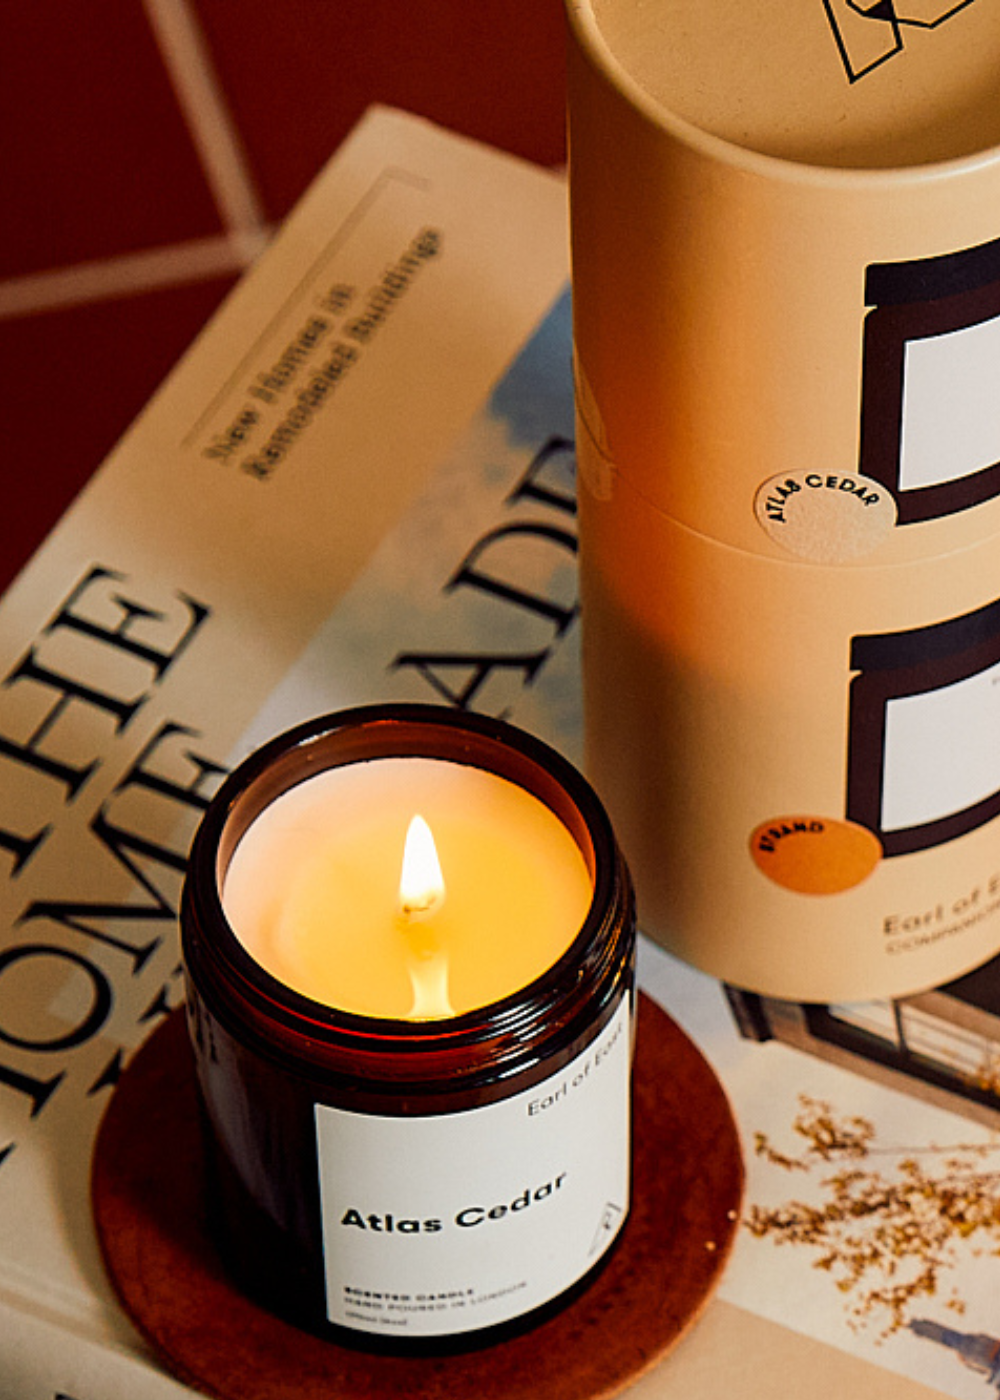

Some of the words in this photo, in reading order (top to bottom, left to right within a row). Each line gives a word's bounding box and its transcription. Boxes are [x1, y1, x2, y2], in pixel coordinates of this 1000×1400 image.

[204, 403, 260, 465] New
[248, 315, 332, 405] Homes
[316, 283, 355, 316] in
[240, 342, 359, 481] Remodeled
[345, 226, 443, 345] Buildings
[766, 479, 801, 523] ATLAS
[805, 474, 880, 506] CEDAR
[883, 904, 943, 936] Earl
[952, 887, 980, 914] of
[527, 1081, 567, 1117] Earl
[572, 1062, 591, 1088] of
[340, 1208, 443, 1234] Atlas
[455, 1171, 567, 1228] Cedar
[344, 1286, 411, 1301] SCENTED
[415, 1287, 473, 1301] CANDLE
[344, 1297, 383, 1310] HAND
[387, 1301, 447, 1313] POURED
